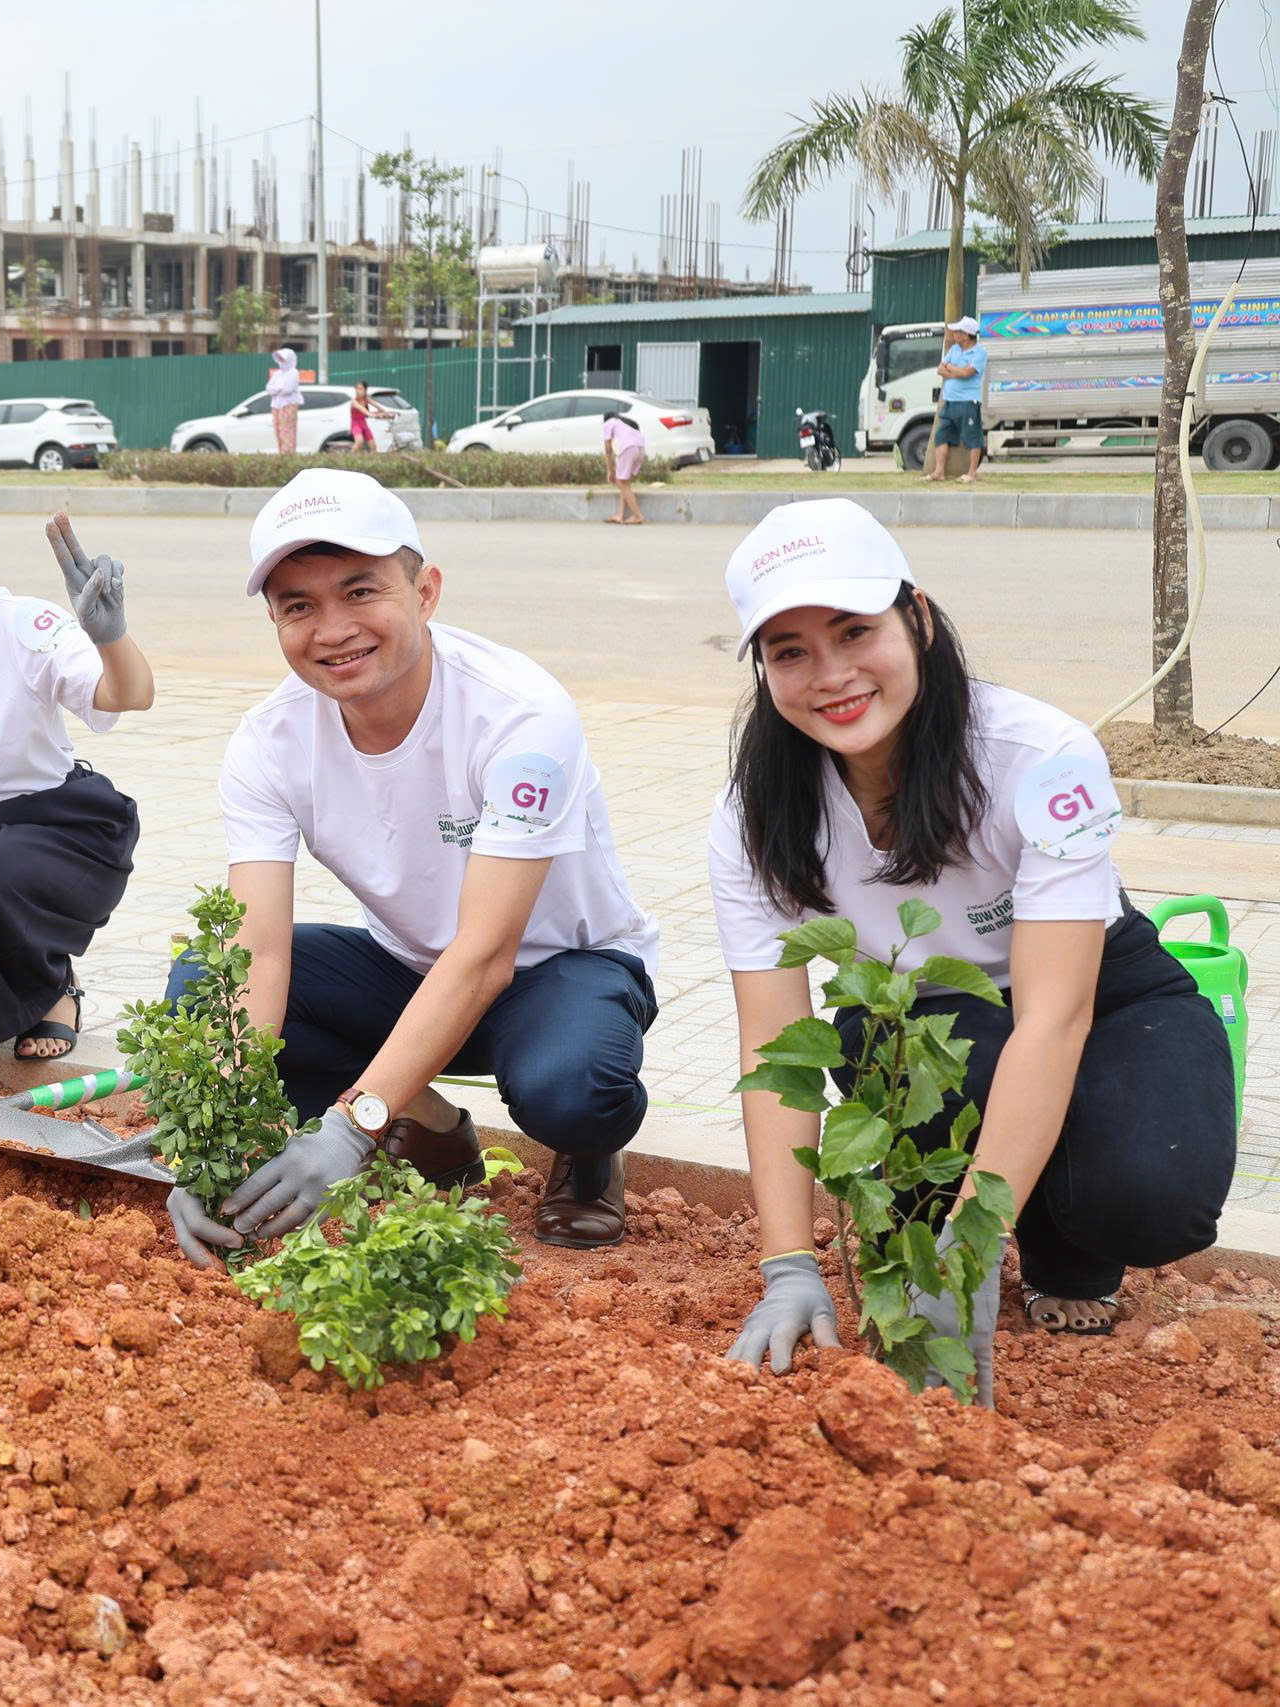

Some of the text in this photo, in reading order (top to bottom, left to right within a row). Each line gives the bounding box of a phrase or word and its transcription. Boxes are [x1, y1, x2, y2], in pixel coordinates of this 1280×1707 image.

[304, 495, 340, 509] MALL
[782, 535, 825, 554] MALL
[33, 609, 61, 631] G1
[512, 782, 549, 812] G1
[1048, 783, 1094, 822] G1
[992, 898, 1013, 917] the
